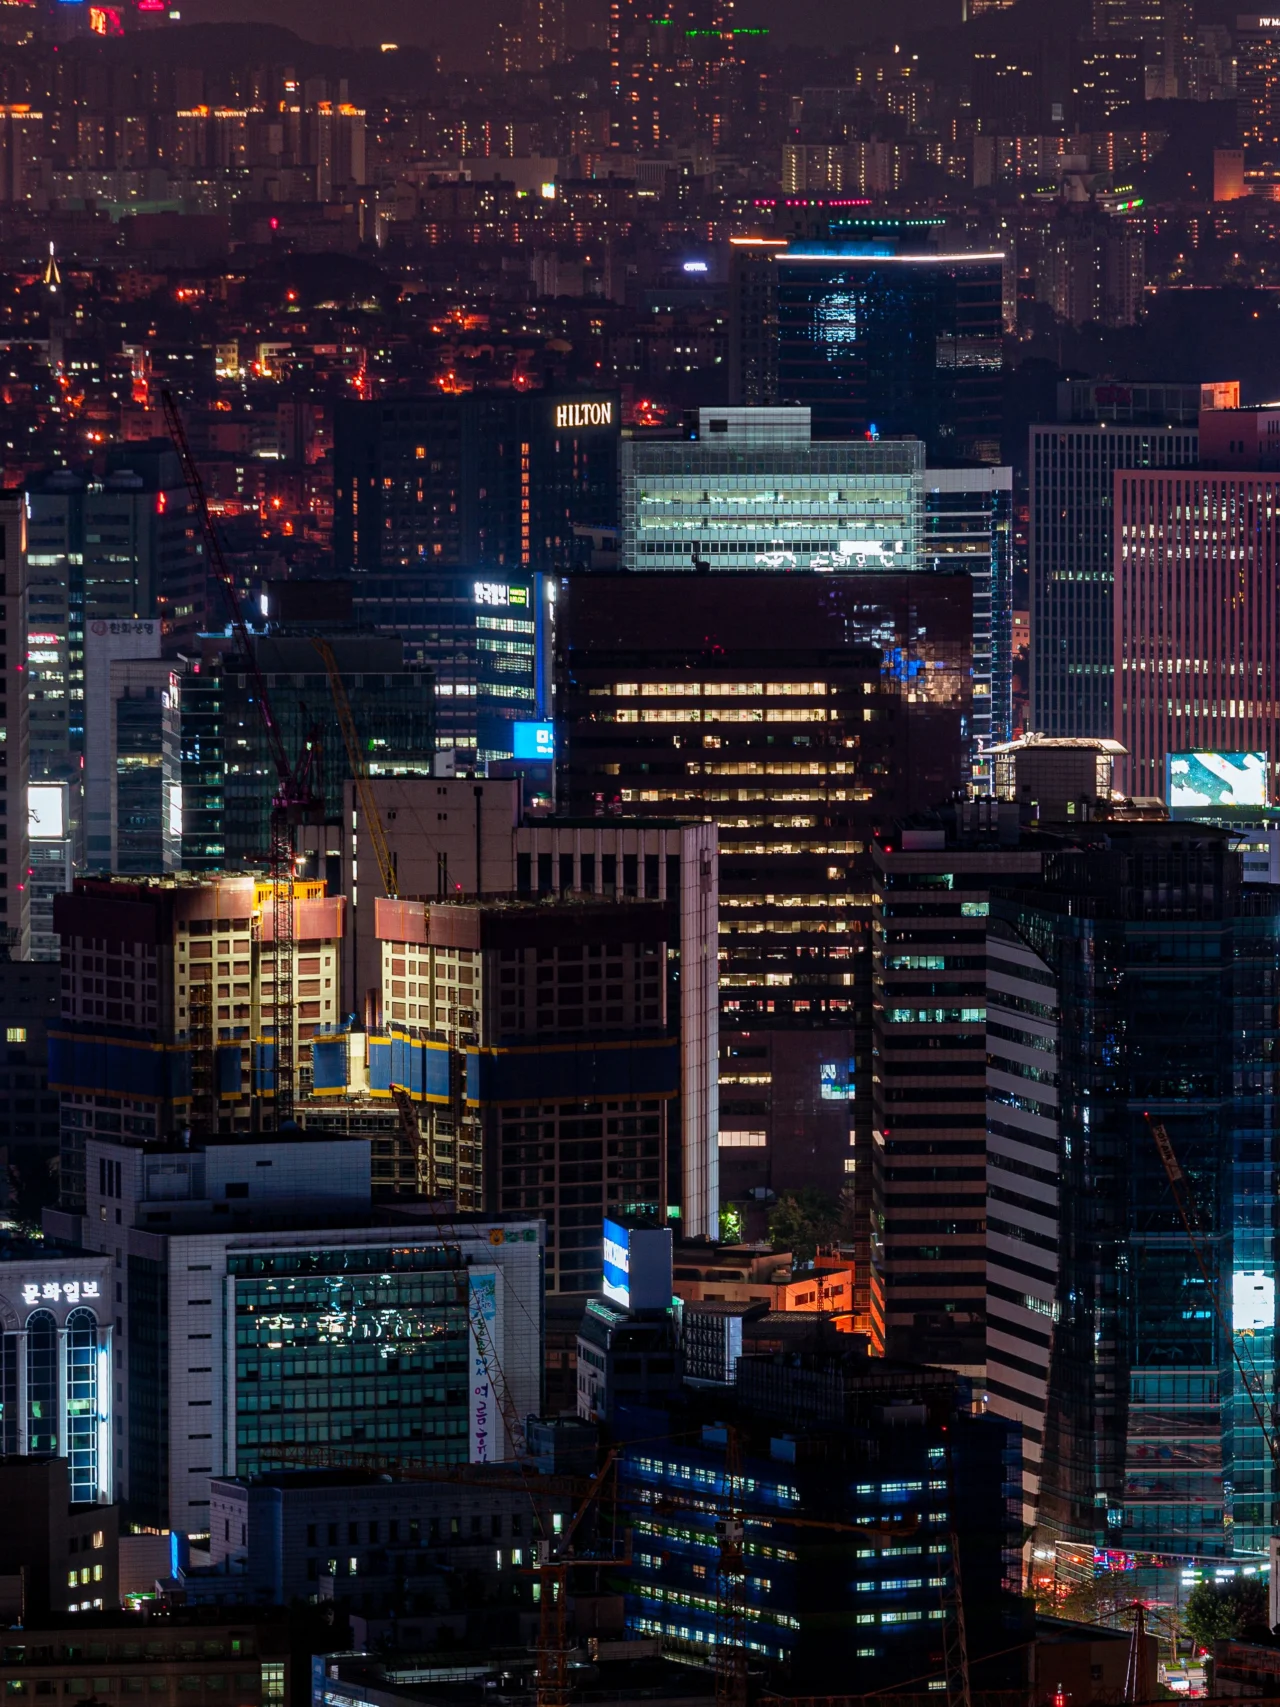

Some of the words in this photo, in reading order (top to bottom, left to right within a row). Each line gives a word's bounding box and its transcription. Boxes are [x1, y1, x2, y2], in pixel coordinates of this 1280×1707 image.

[1259, 18, 1271, 27] JW
[556, 401, 612, 427] HILTON
[474, 581, 507, 606] 한국일보
[109, 622, 155, 635] 한화생명
[21, 1281, 101, 1304] 문화일보
